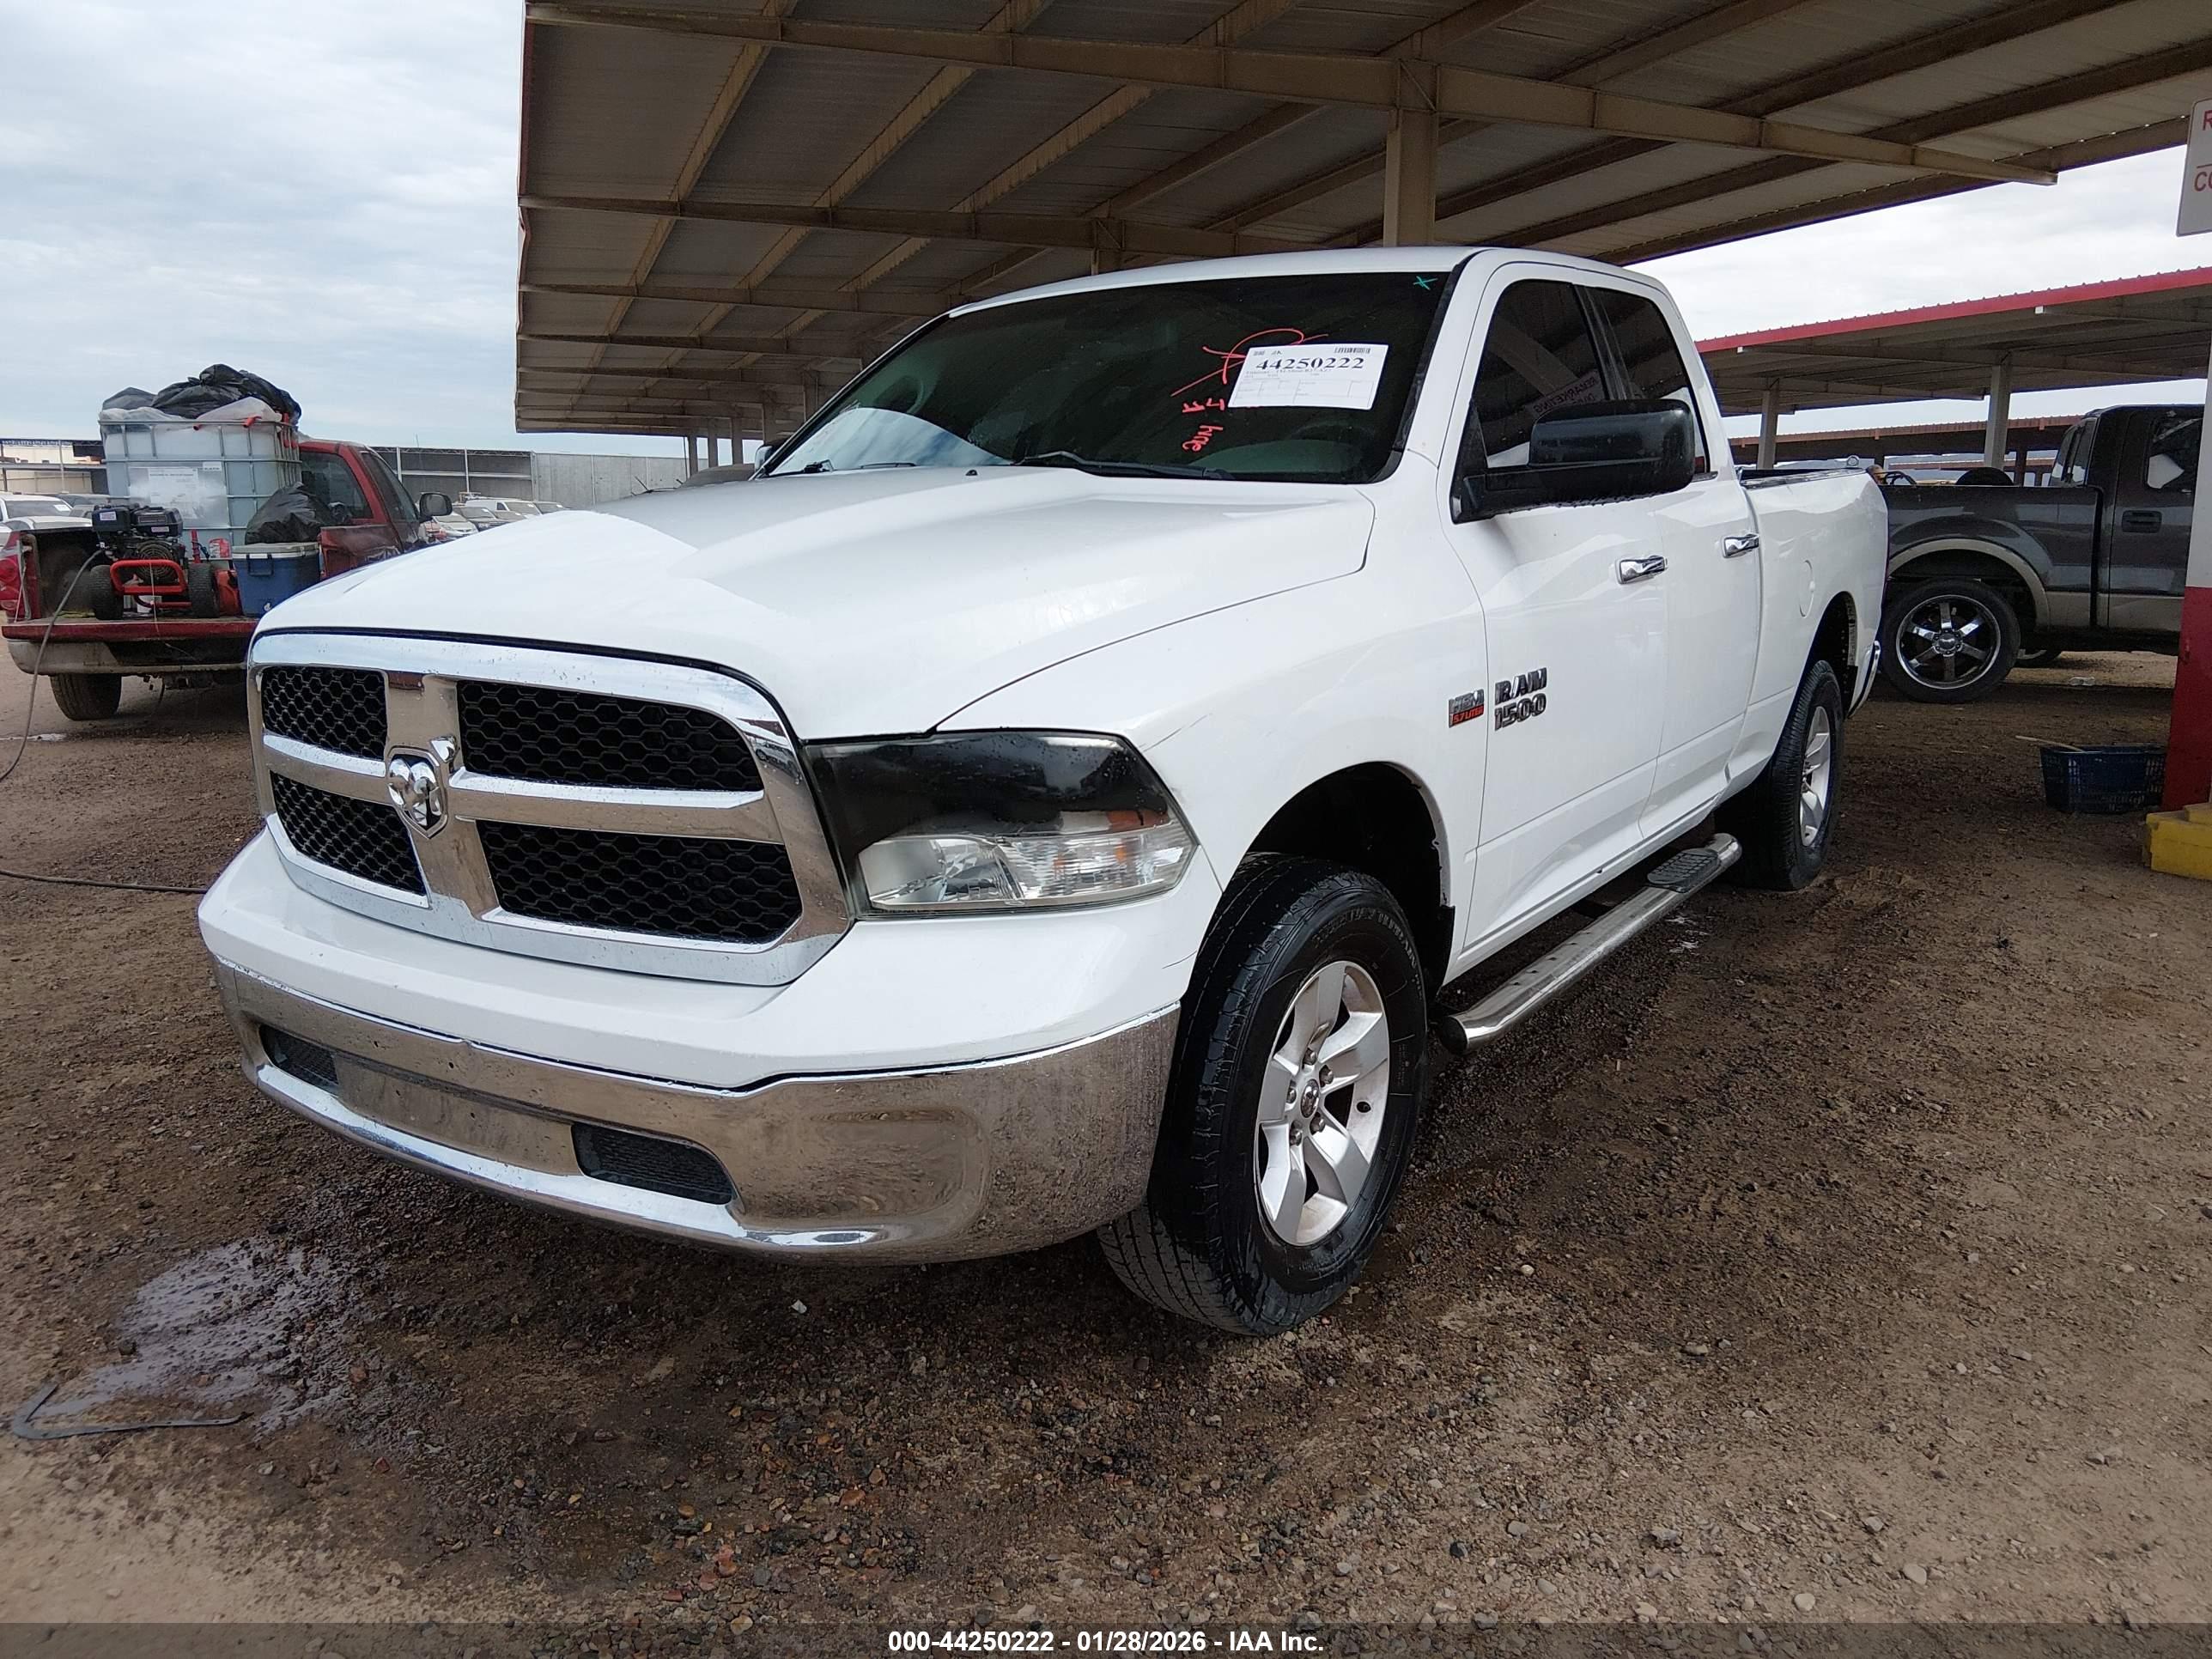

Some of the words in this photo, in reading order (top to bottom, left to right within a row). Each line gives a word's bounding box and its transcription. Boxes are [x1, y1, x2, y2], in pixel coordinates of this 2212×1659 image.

[1255, 356, 1364, 370] 44250222
[1494, 667, 1547, 705] RAM
[1494, 693, 1547, 731] 1500
